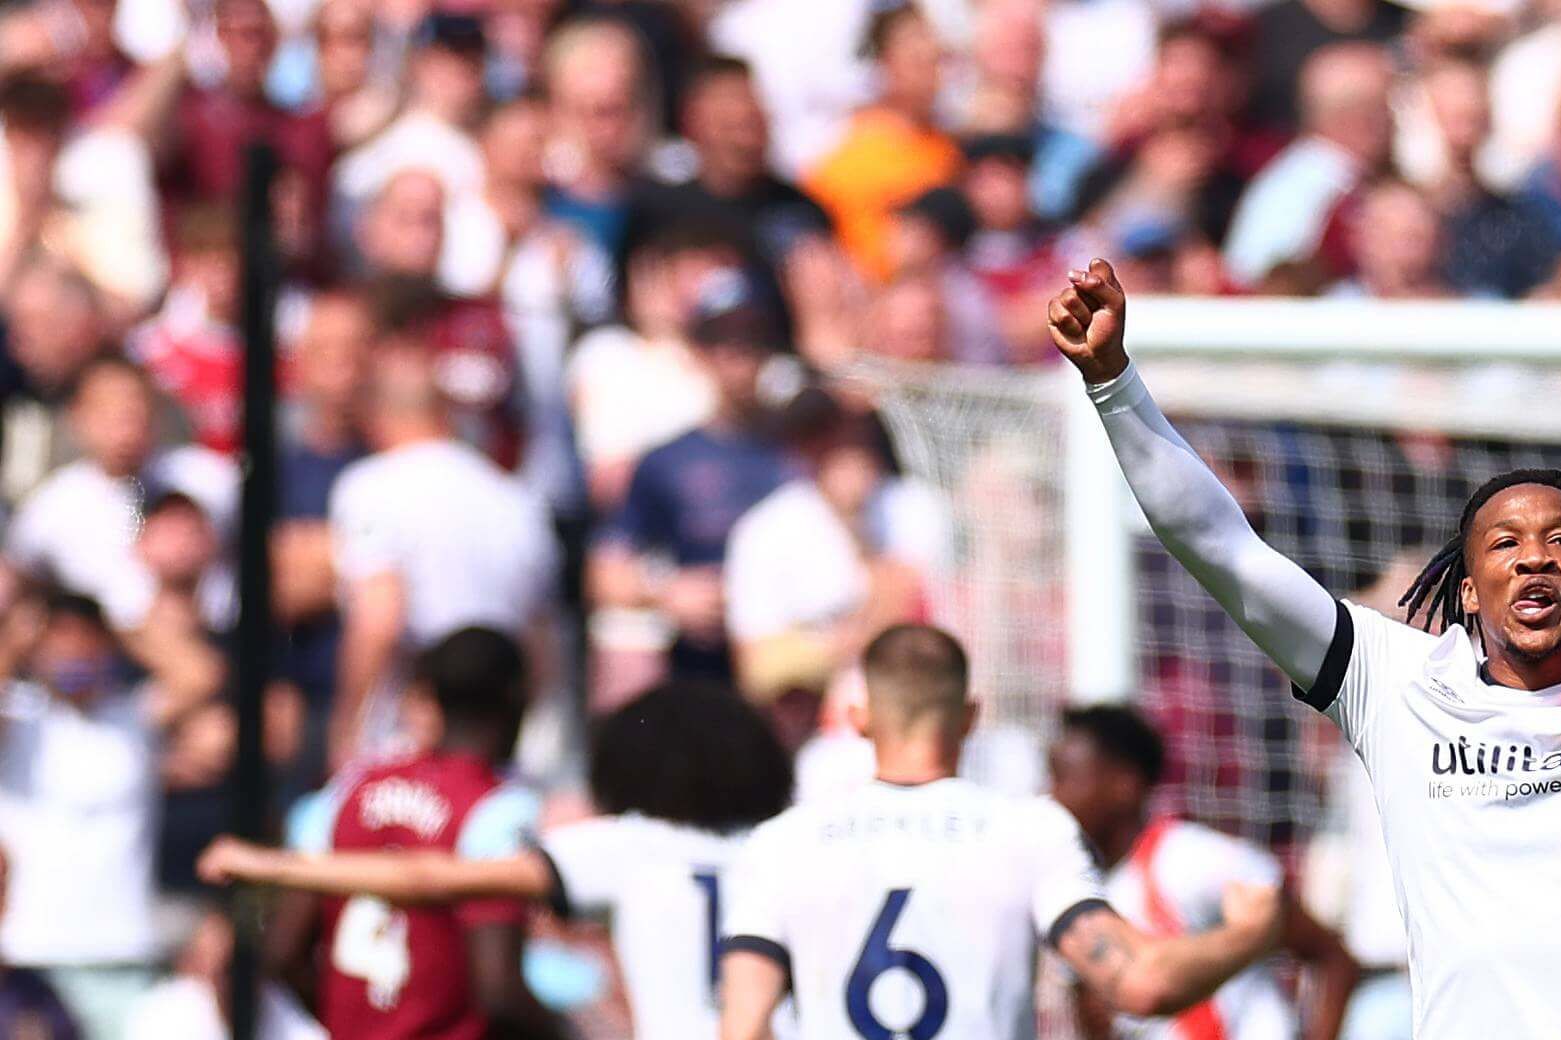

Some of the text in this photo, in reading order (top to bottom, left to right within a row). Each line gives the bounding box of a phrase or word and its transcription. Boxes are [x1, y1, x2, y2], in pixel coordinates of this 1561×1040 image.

[1428, 780, 1454, 799] life
[1460, 778, 1499, 797] with
[332, 894, 411, 1013] 4
